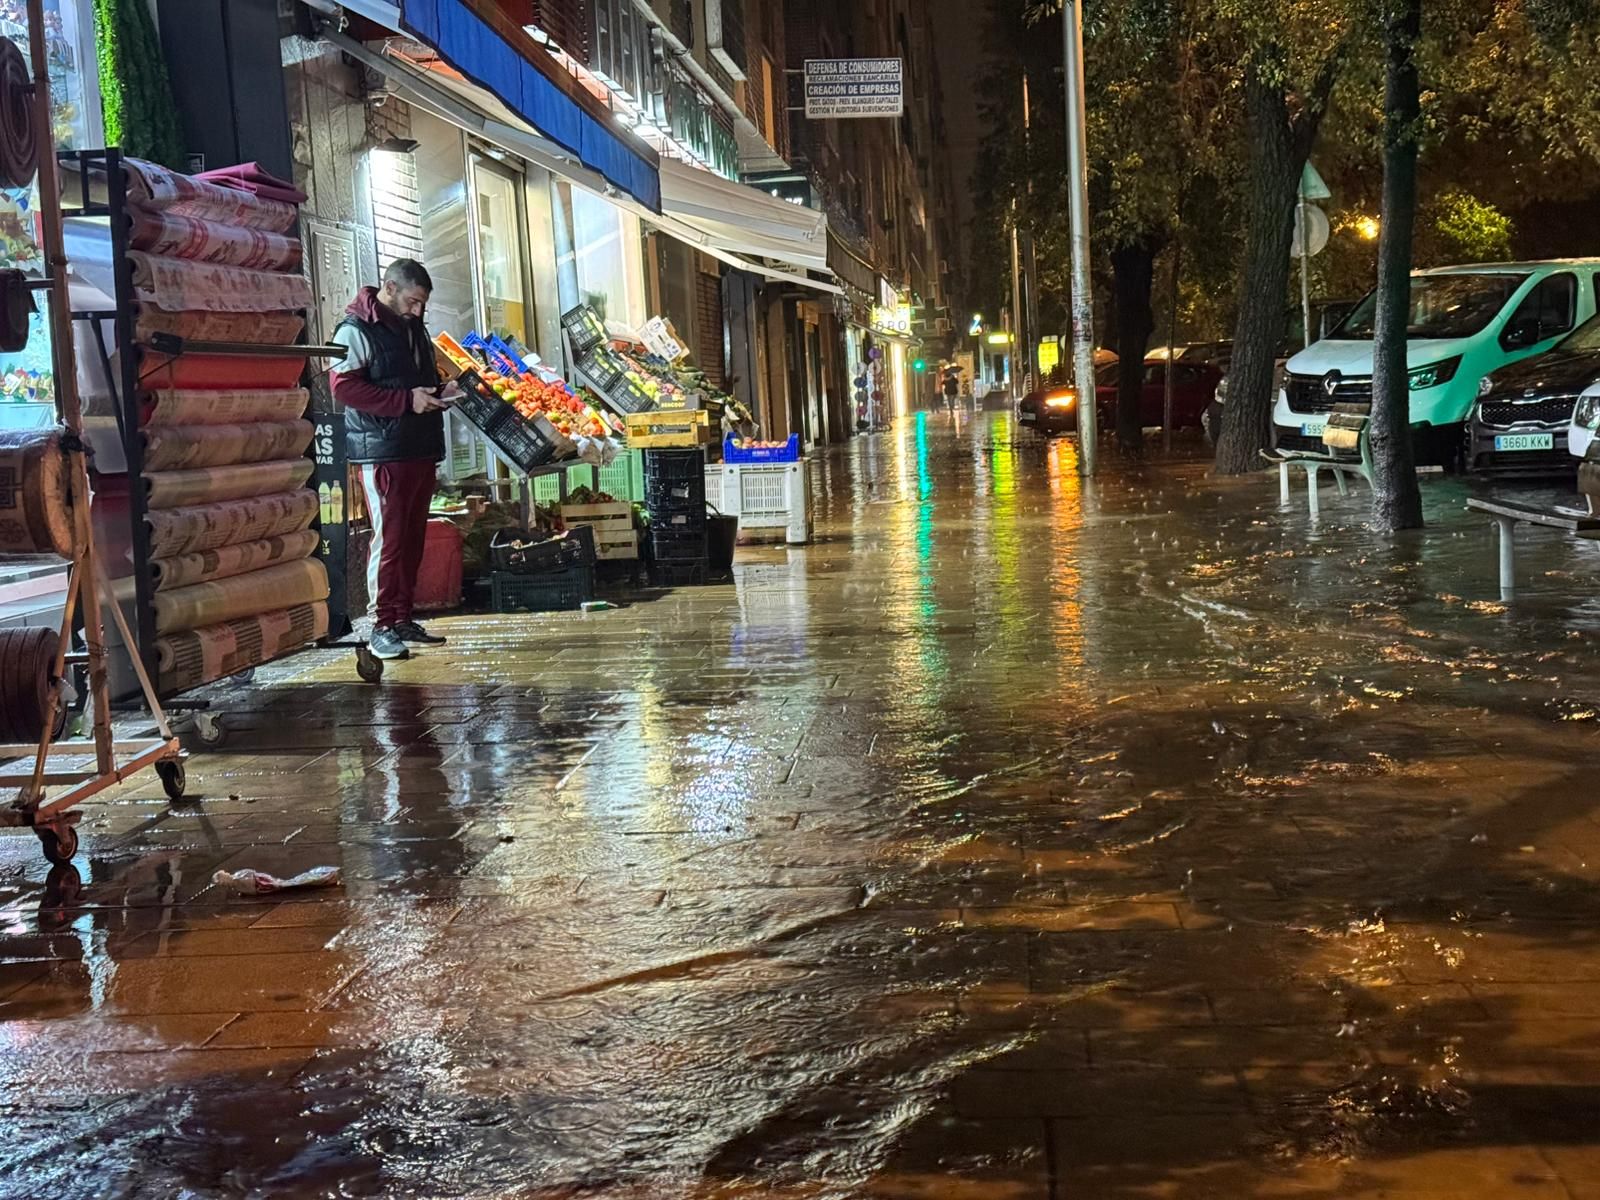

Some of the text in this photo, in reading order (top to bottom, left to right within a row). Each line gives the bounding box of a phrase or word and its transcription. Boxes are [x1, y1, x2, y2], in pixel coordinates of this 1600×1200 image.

[808, 61, 899, 74] DEFENSA DE CONSUMIDORES
[808, 84, 899, 95] CREACIÓN DE EMPRESAS
[1503, 436, 1550, 448] 3660 KKW
